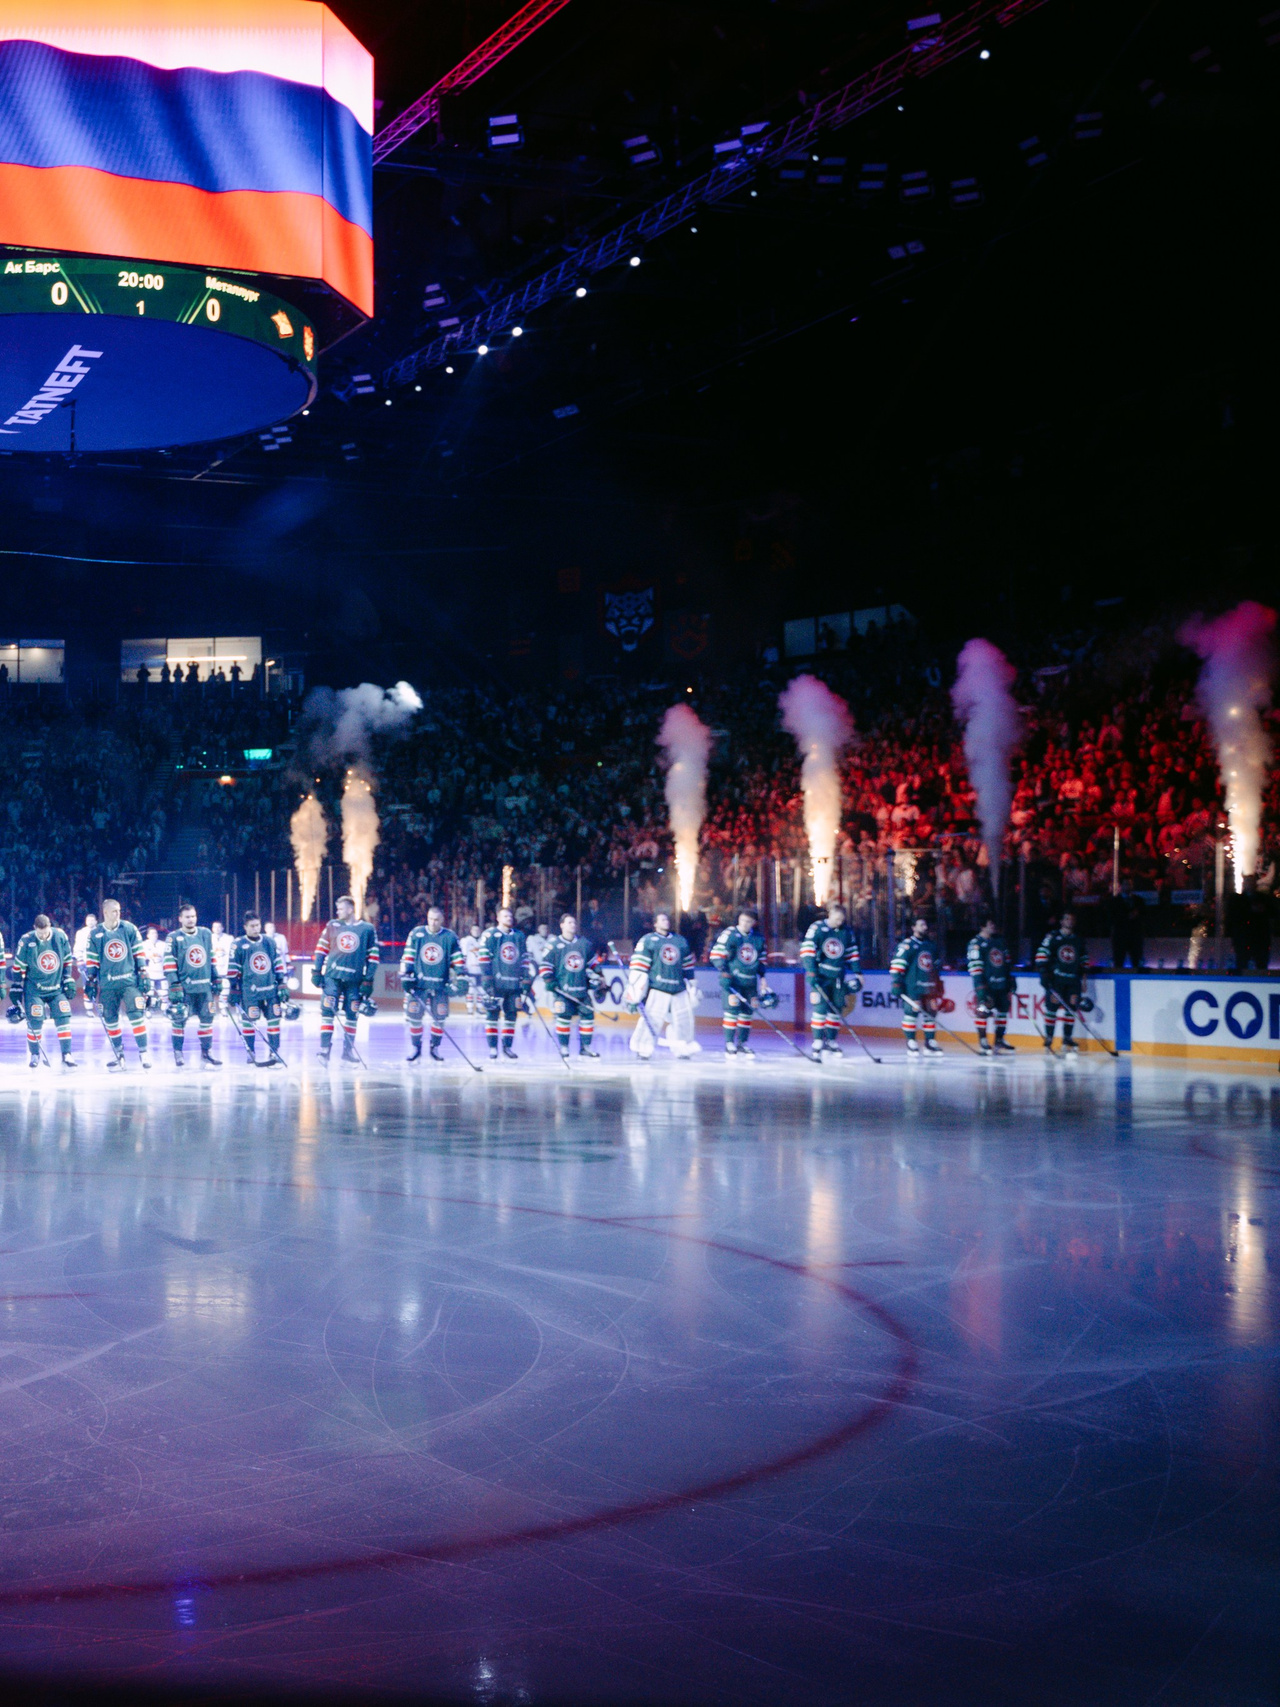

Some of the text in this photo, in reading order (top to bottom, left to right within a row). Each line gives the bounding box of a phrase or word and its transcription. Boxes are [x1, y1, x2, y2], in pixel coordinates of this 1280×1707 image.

[4, 260, 60, 275] Ак Барс
[118, 271, 164, 290] 20:00
[51, 281, 68, 306] 0
[136, 300, 145, 315] 1
[206, 297, 220, 322] 0
[3, 344, 104, 425] TATNEFT
[861, 991, 901, 1009] БАН
